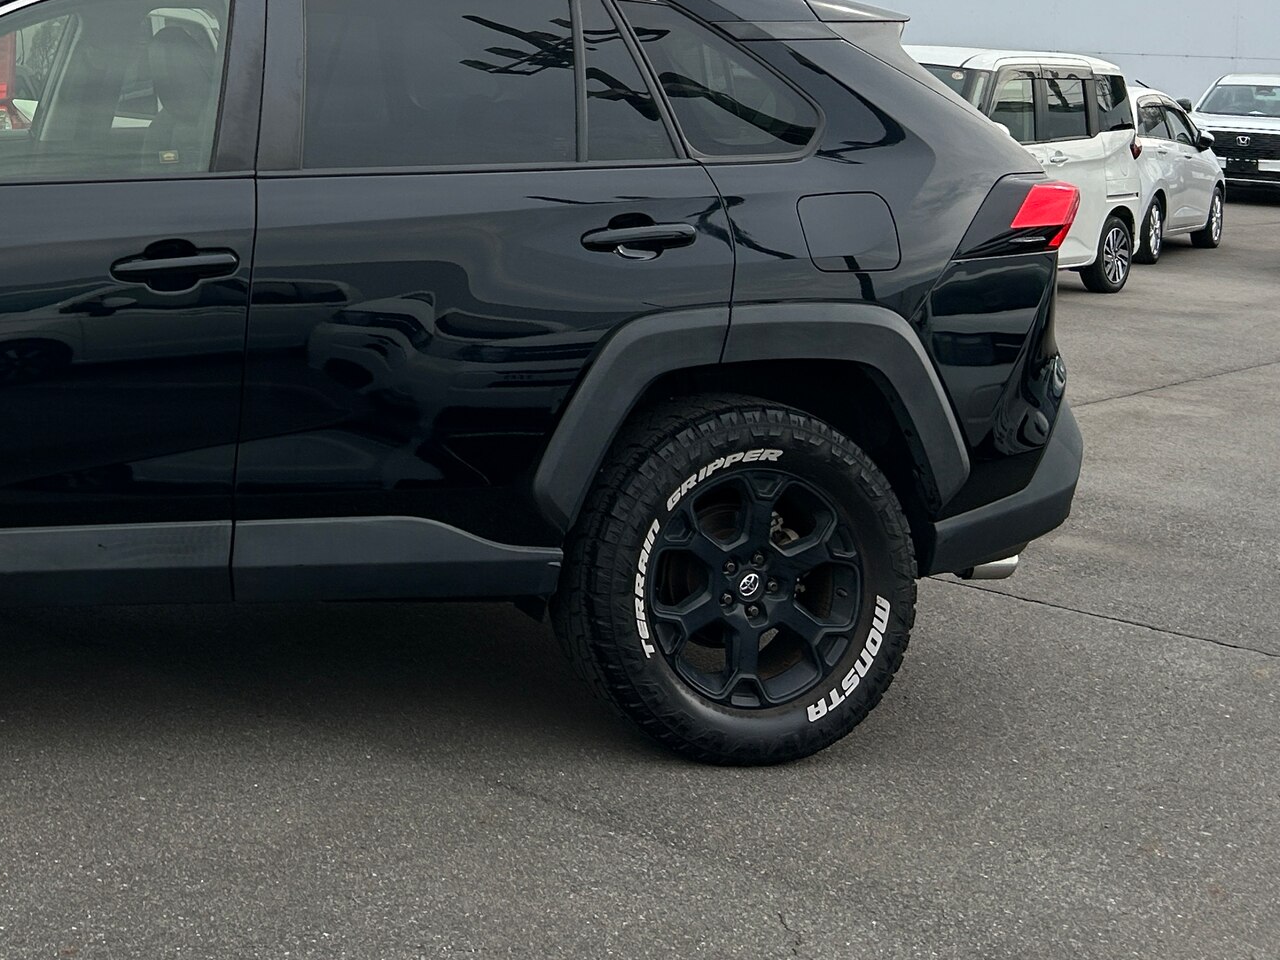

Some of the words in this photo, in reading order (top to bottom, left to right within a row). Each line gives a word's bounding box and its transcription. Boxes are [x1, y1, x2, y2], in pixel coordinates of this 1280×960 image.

[634, 518, 660, 659] TERRAIN
[666, 448, 783, 511] GRIPPER
[806, 594, 891, 722] MONSTA
